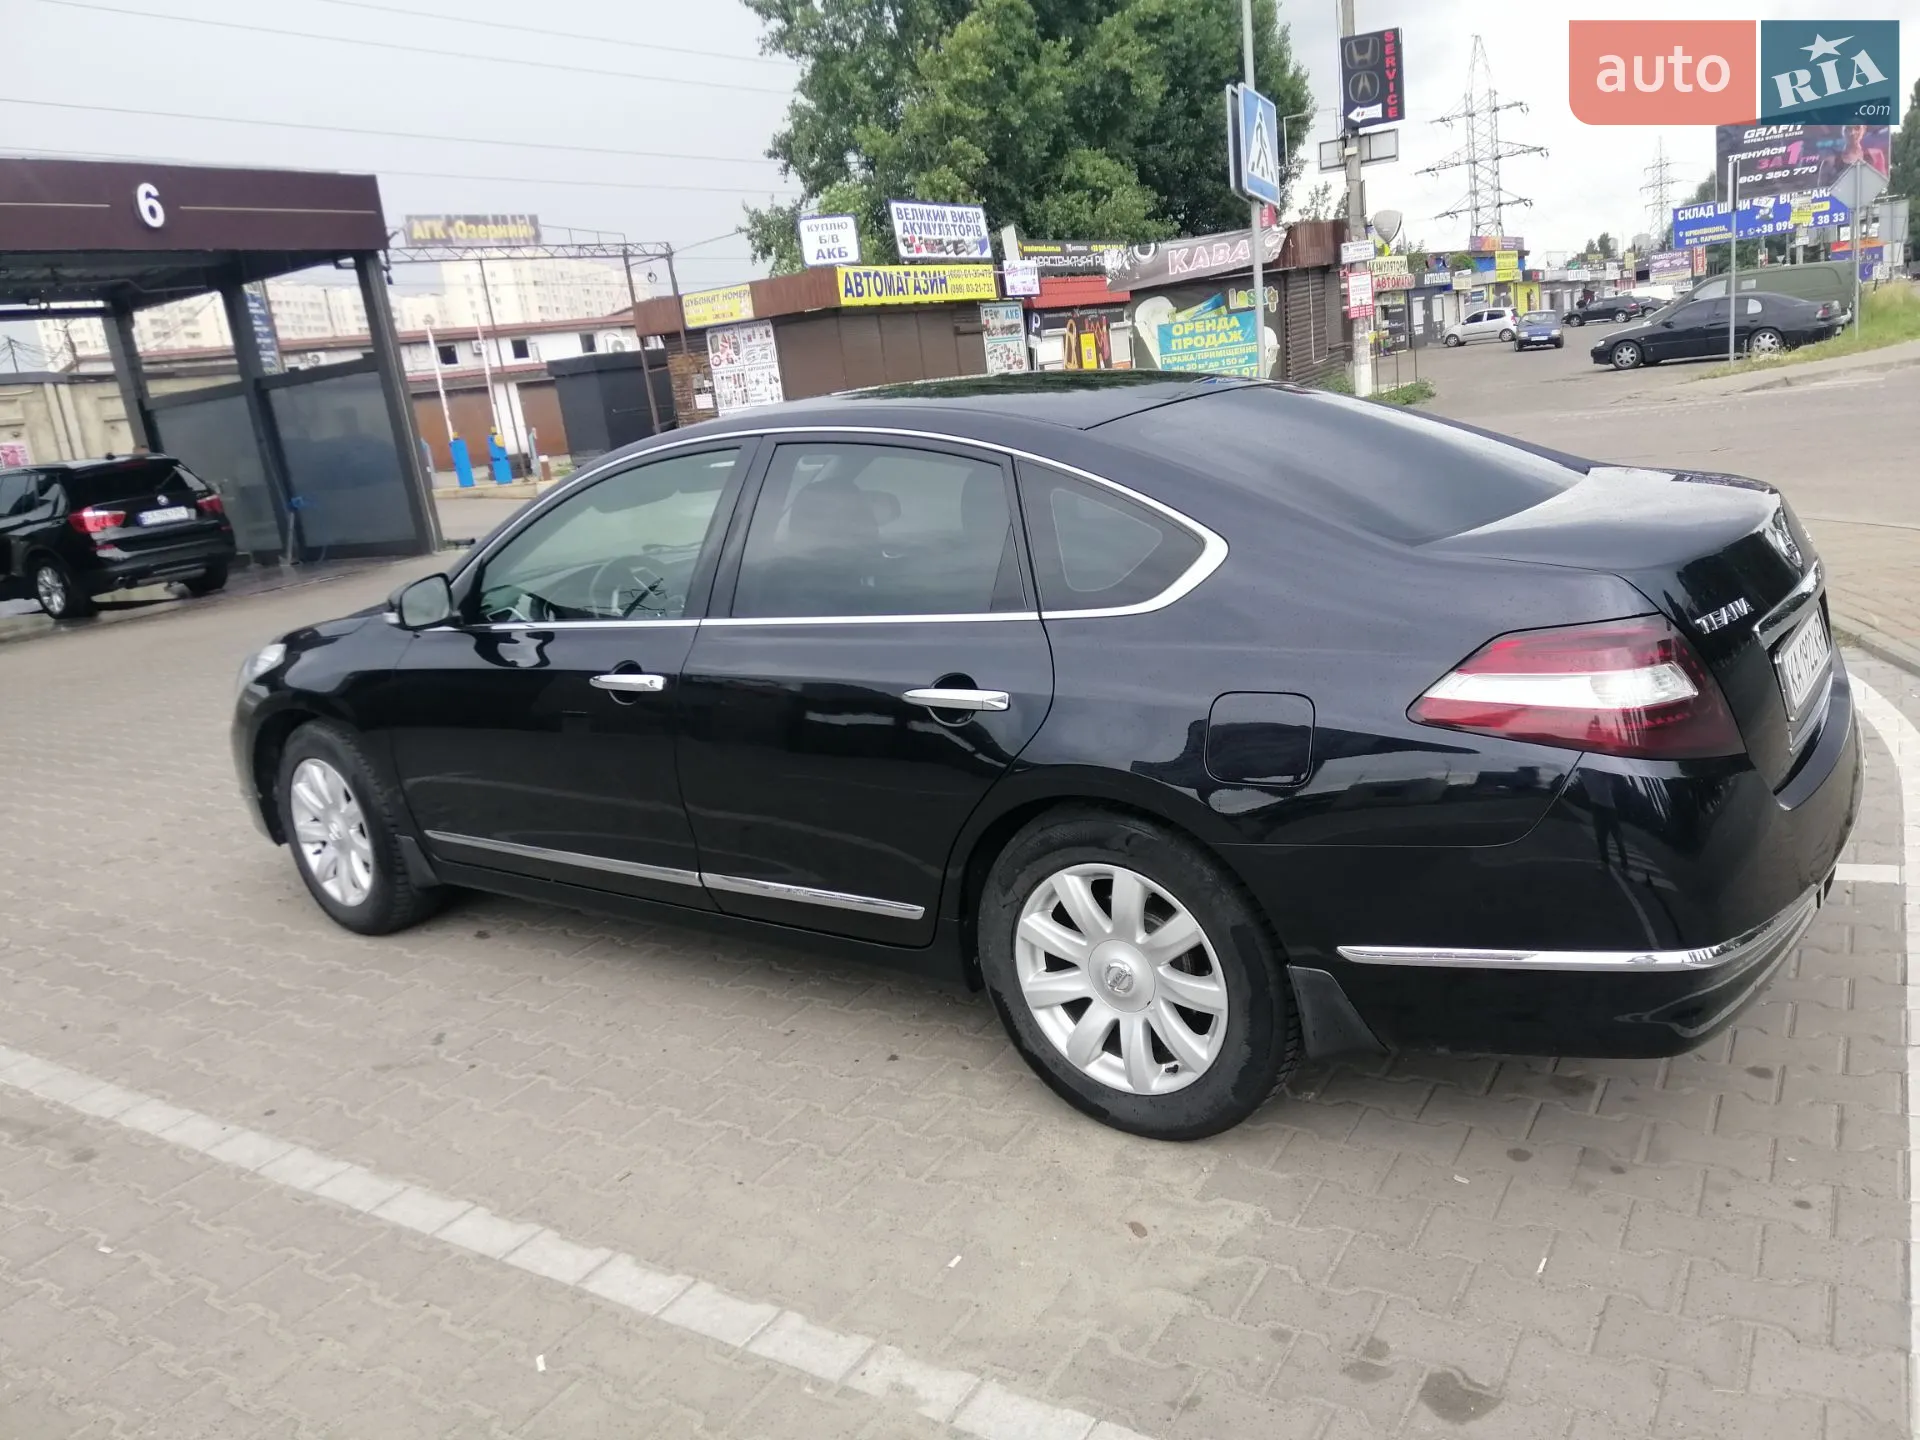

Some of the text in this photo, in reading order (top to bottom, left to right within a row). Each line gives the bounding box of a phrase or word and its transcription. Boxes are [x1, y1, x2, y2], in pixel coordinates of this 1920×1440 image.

[1384, 31, 1398, 118] SERVICE
[1744, 122, 1804, 139] GRAFIT
[1728, 146, 1787, 162] ТРЕНУЙСЯ
[1757, 155, 1783, 170] ЗА
[1787, 140, 1804, 165] 1
[1739, 165, 1818, 184] 800 350 770
[137, 182, 165, 228] 6
[1678, 204, 1715, 221] СКЛАД
[895, 206, 982, 224] ВЕЛИКИЙ ВИБІР
[1756, 223, 1773, 234] +38
[1817, 215, 1830, 226] 38
[1832, 211, 1845, 223] 33
[412, 219, 446, 240] АГК
[807, 221, 848, 232] КУПЛЮ
[902, 221, 982, 237] АКУМУЛЯТОРІВ
[818, 233, 840, 244] Б/В
[816, 246, 849, 260] АКБ
[1168, 239, 1251, 275] КАВА
[844, 271, 949, 298] АВТОМАГАЗИН
[1005, 308, 1020, 320] АКБ
[1172, 316, 1240, 336] ОРЕНДА
[1171, 330, 1244, 350] ПРОДАЖ
[1695, 597, 1755, 635] TEANA
